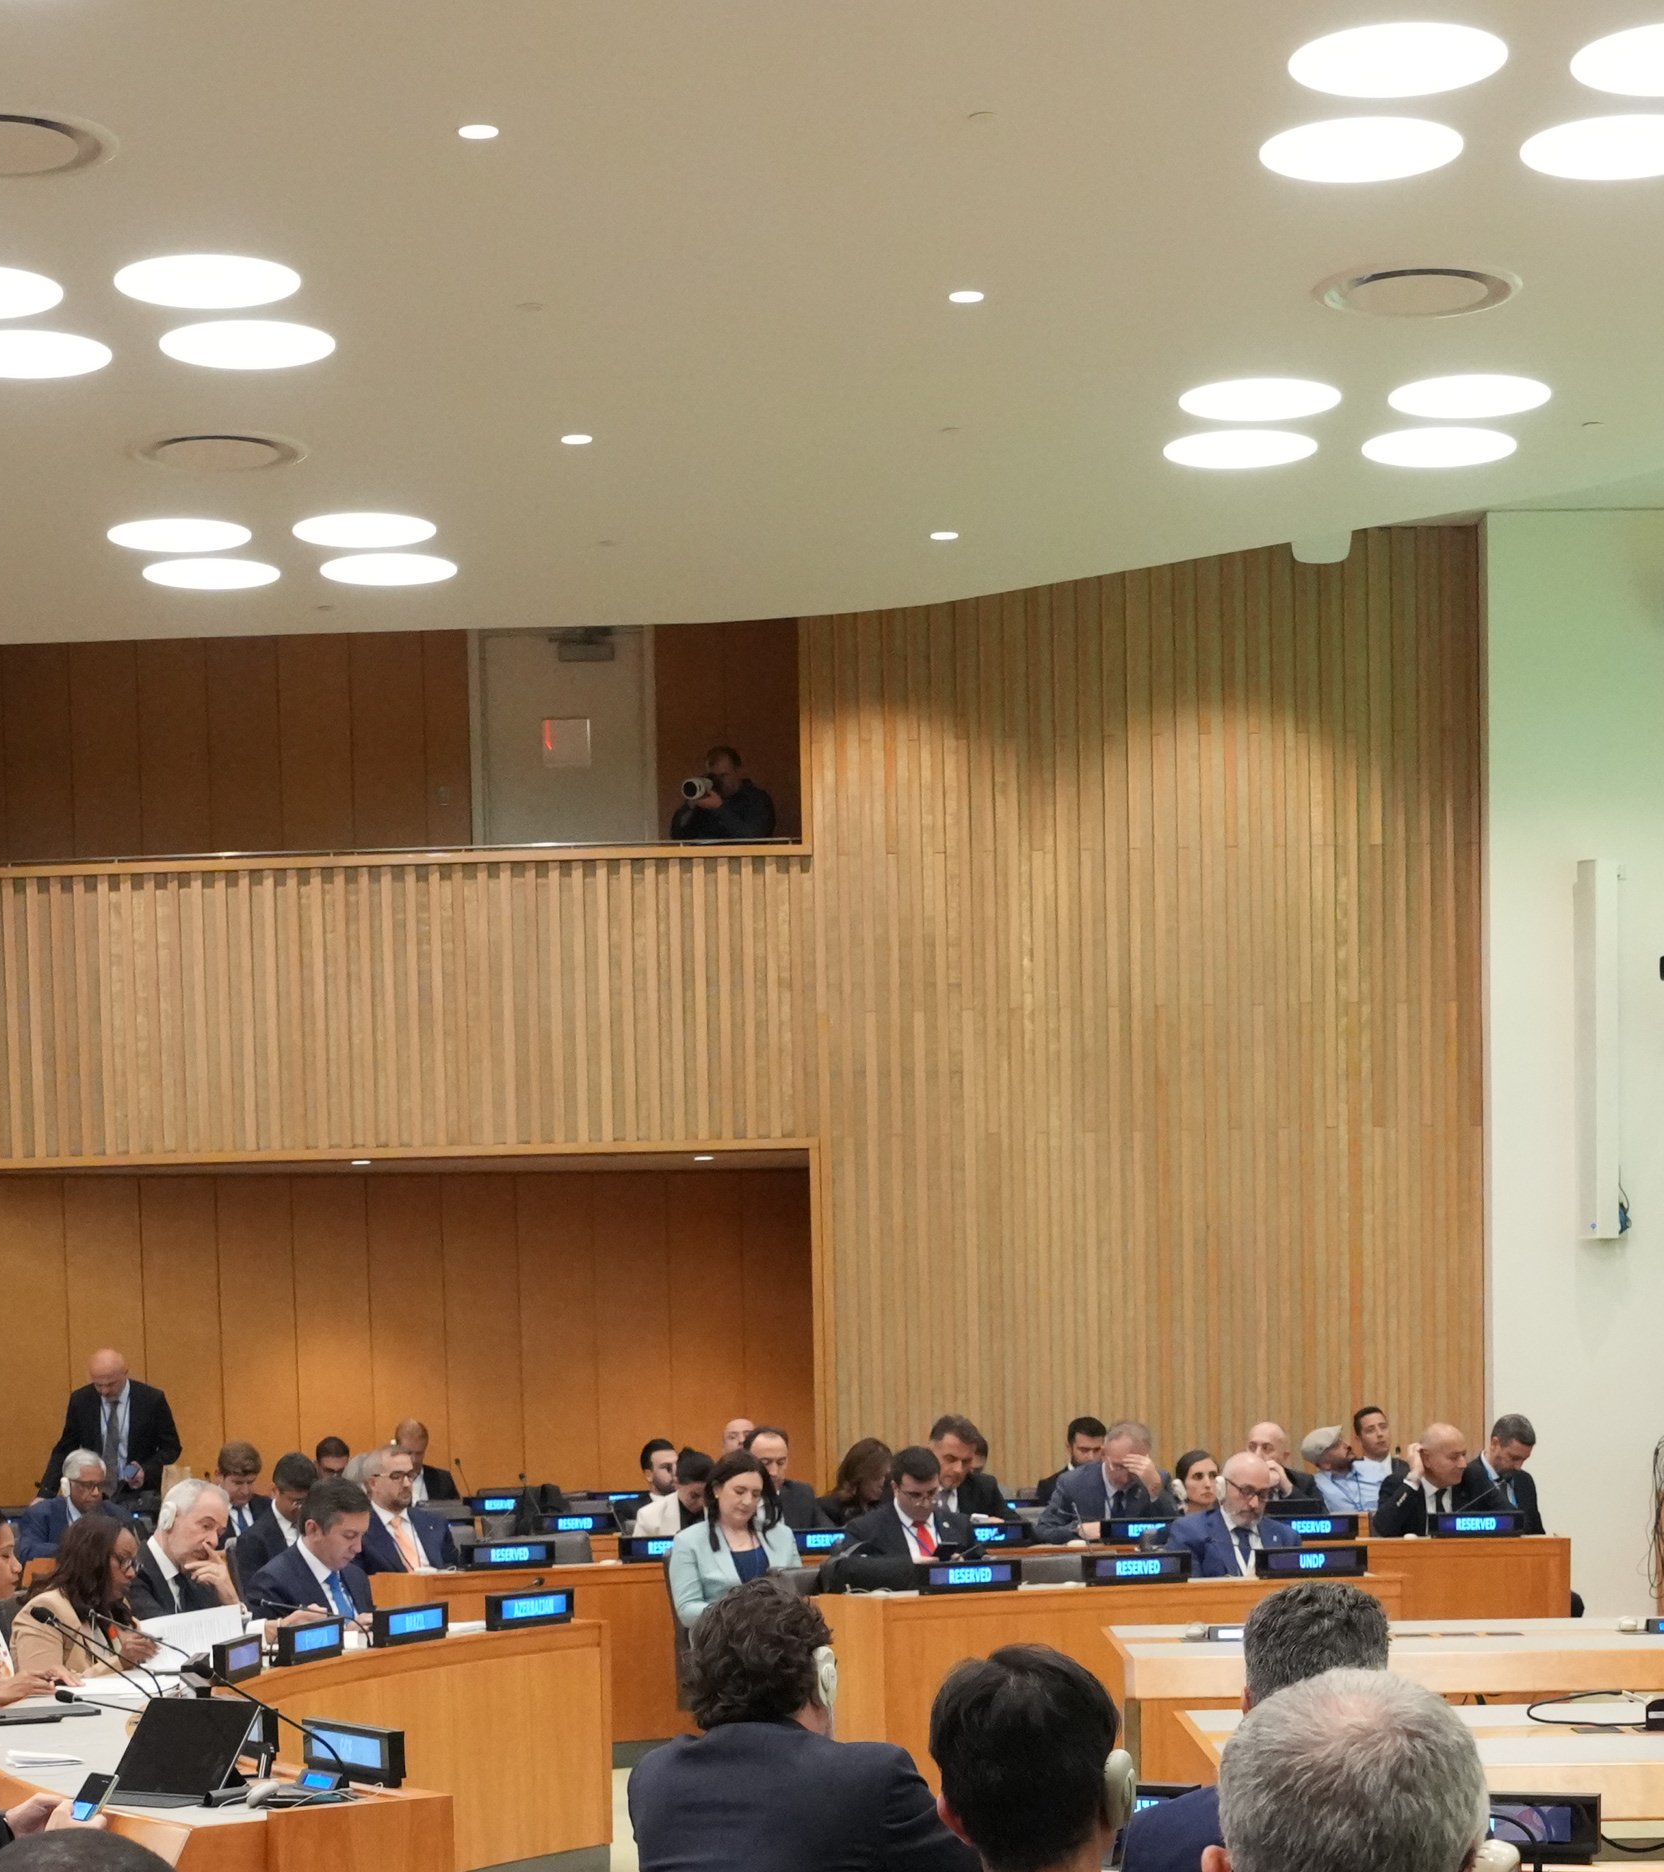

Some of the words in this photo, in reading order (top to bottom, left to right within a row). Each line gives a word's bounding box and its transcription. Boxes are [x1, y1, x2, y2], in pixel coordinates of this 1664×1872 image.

[558, 1518, 592, 1530] RESERVED
[1456, 1518, 1496, 1531] RESERVED
[491, 1547, 529, 1562] RESERVED
[1299, 1554, 1325, 1568] UNDP
[1116, 1559, 1160, 1576] RESERVED
[949, 1567, 992, 1583] RESERVED
